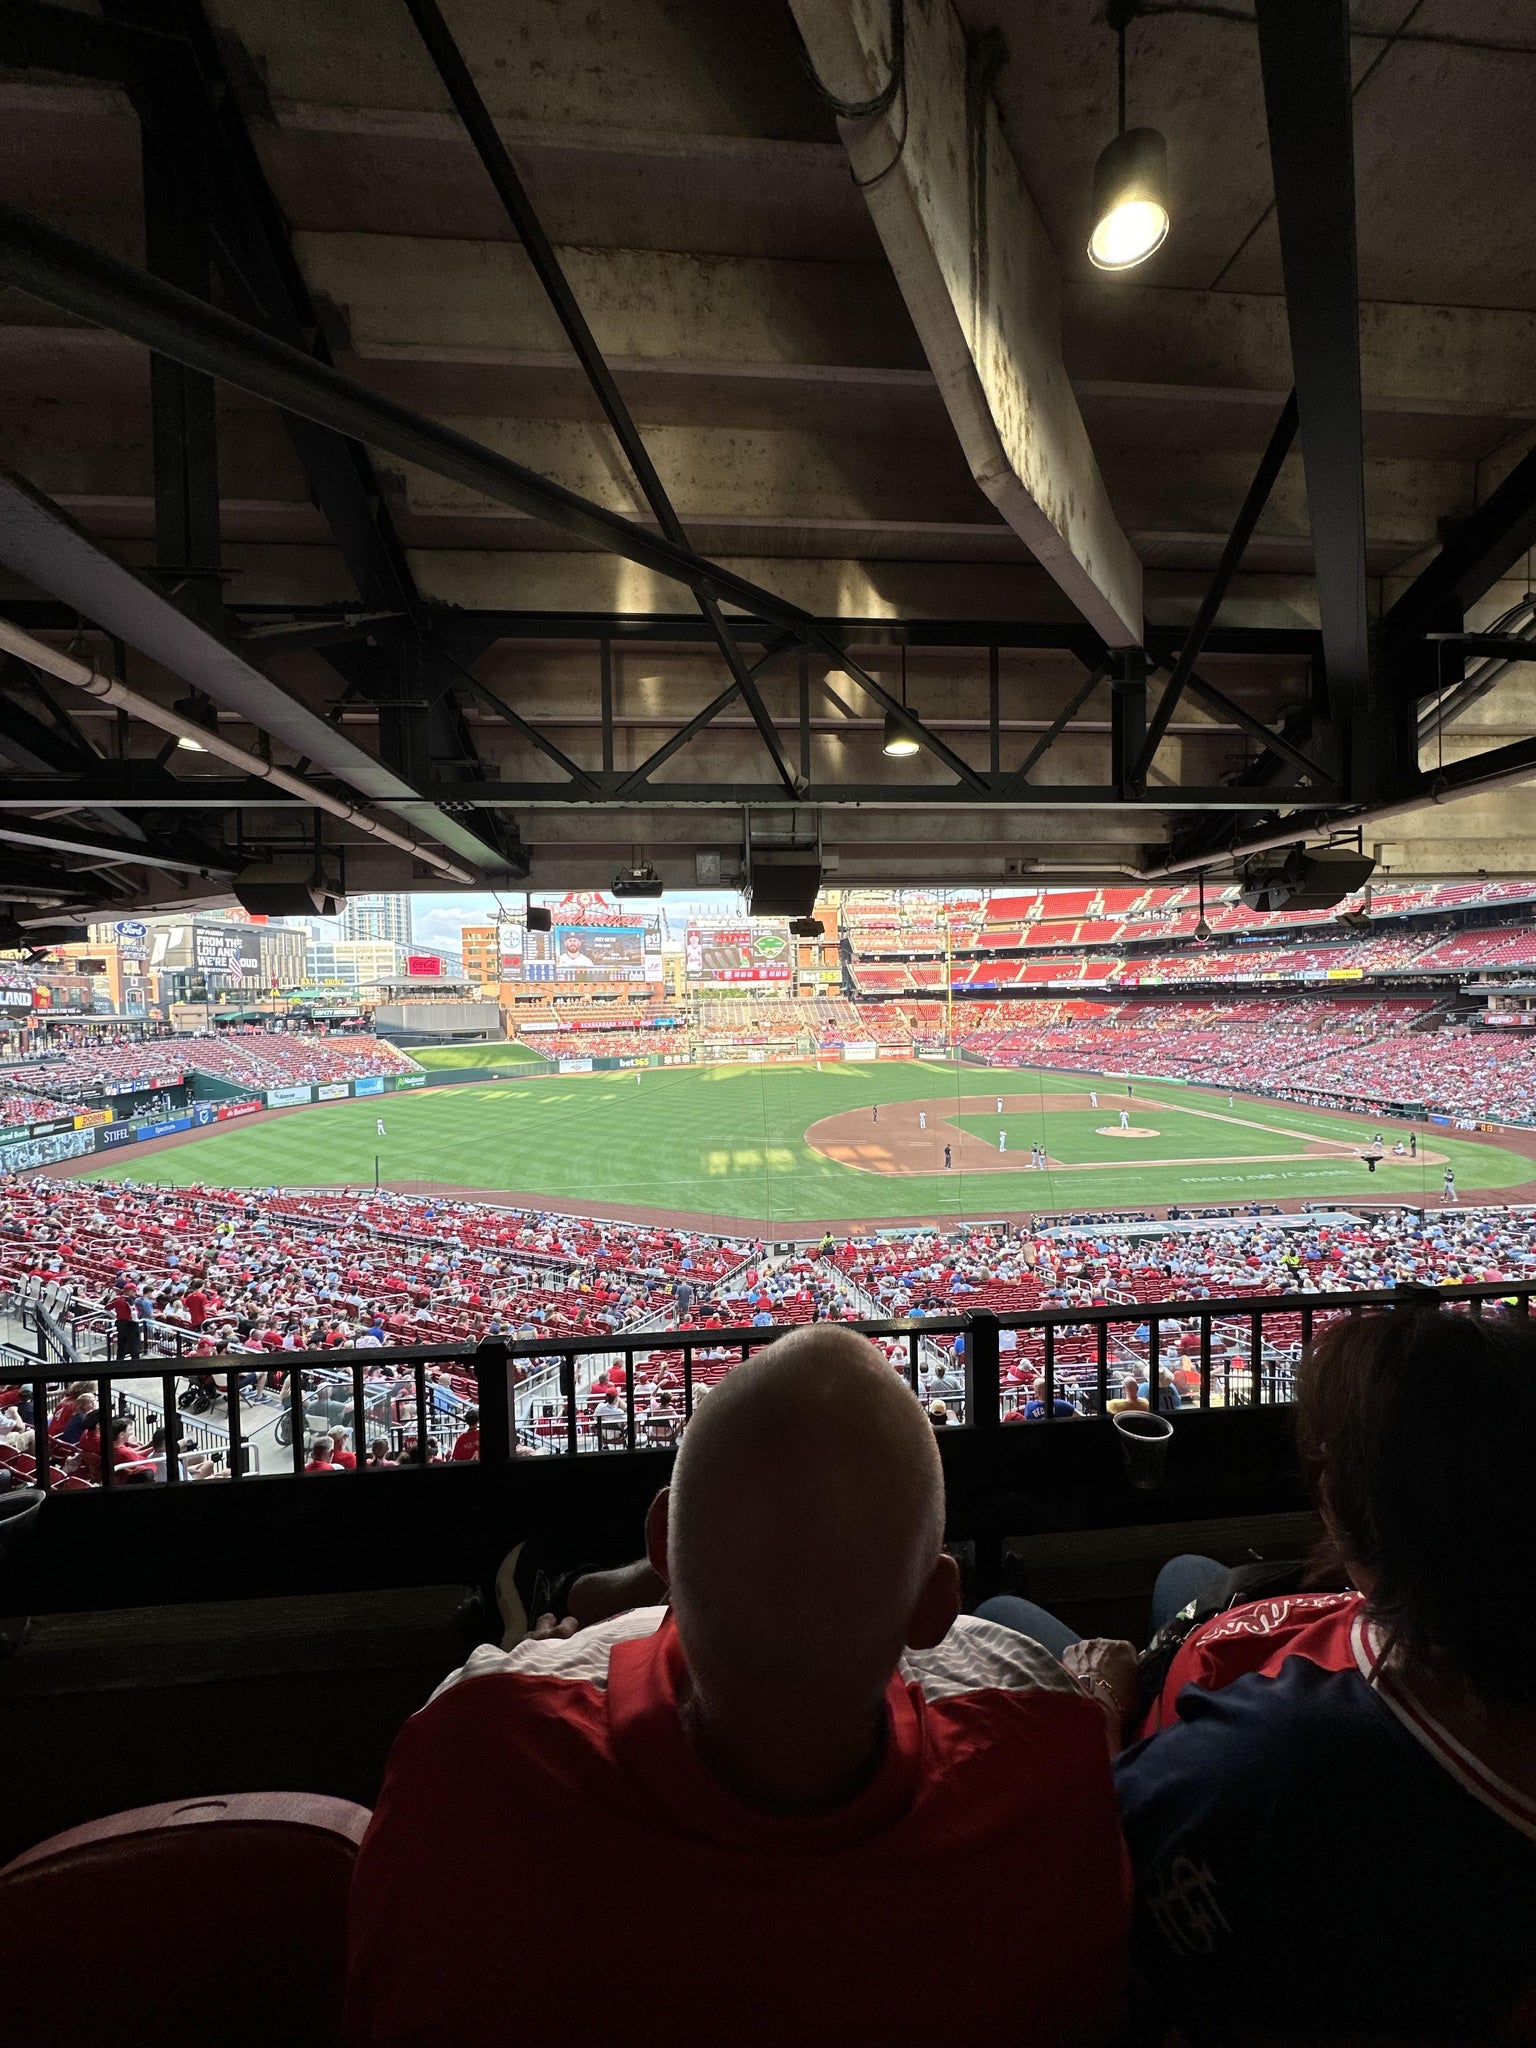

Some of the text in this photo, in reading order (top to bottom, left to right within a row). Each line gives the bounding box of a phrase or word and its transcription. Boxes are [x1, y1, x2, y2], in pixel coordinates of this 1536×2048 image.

[122, 923, 142, 935] Ford
[196, 936, 243, 948] FROM THE
[196, 946, 216, 956] LOU
[196, 956, 227, 967] WE'RE
[0, 991, 32, 1006] LAND
[620, 1058, 649, 1067] bet365
[403, 1075, 425, 1084] National
[83, 1113, 106, 1123] DOBBS
[14, 1129, 30, 1138] Bank
[104, 1129, 129, 1143] STIFEL
[664, 1284, 673, 1295] 22
